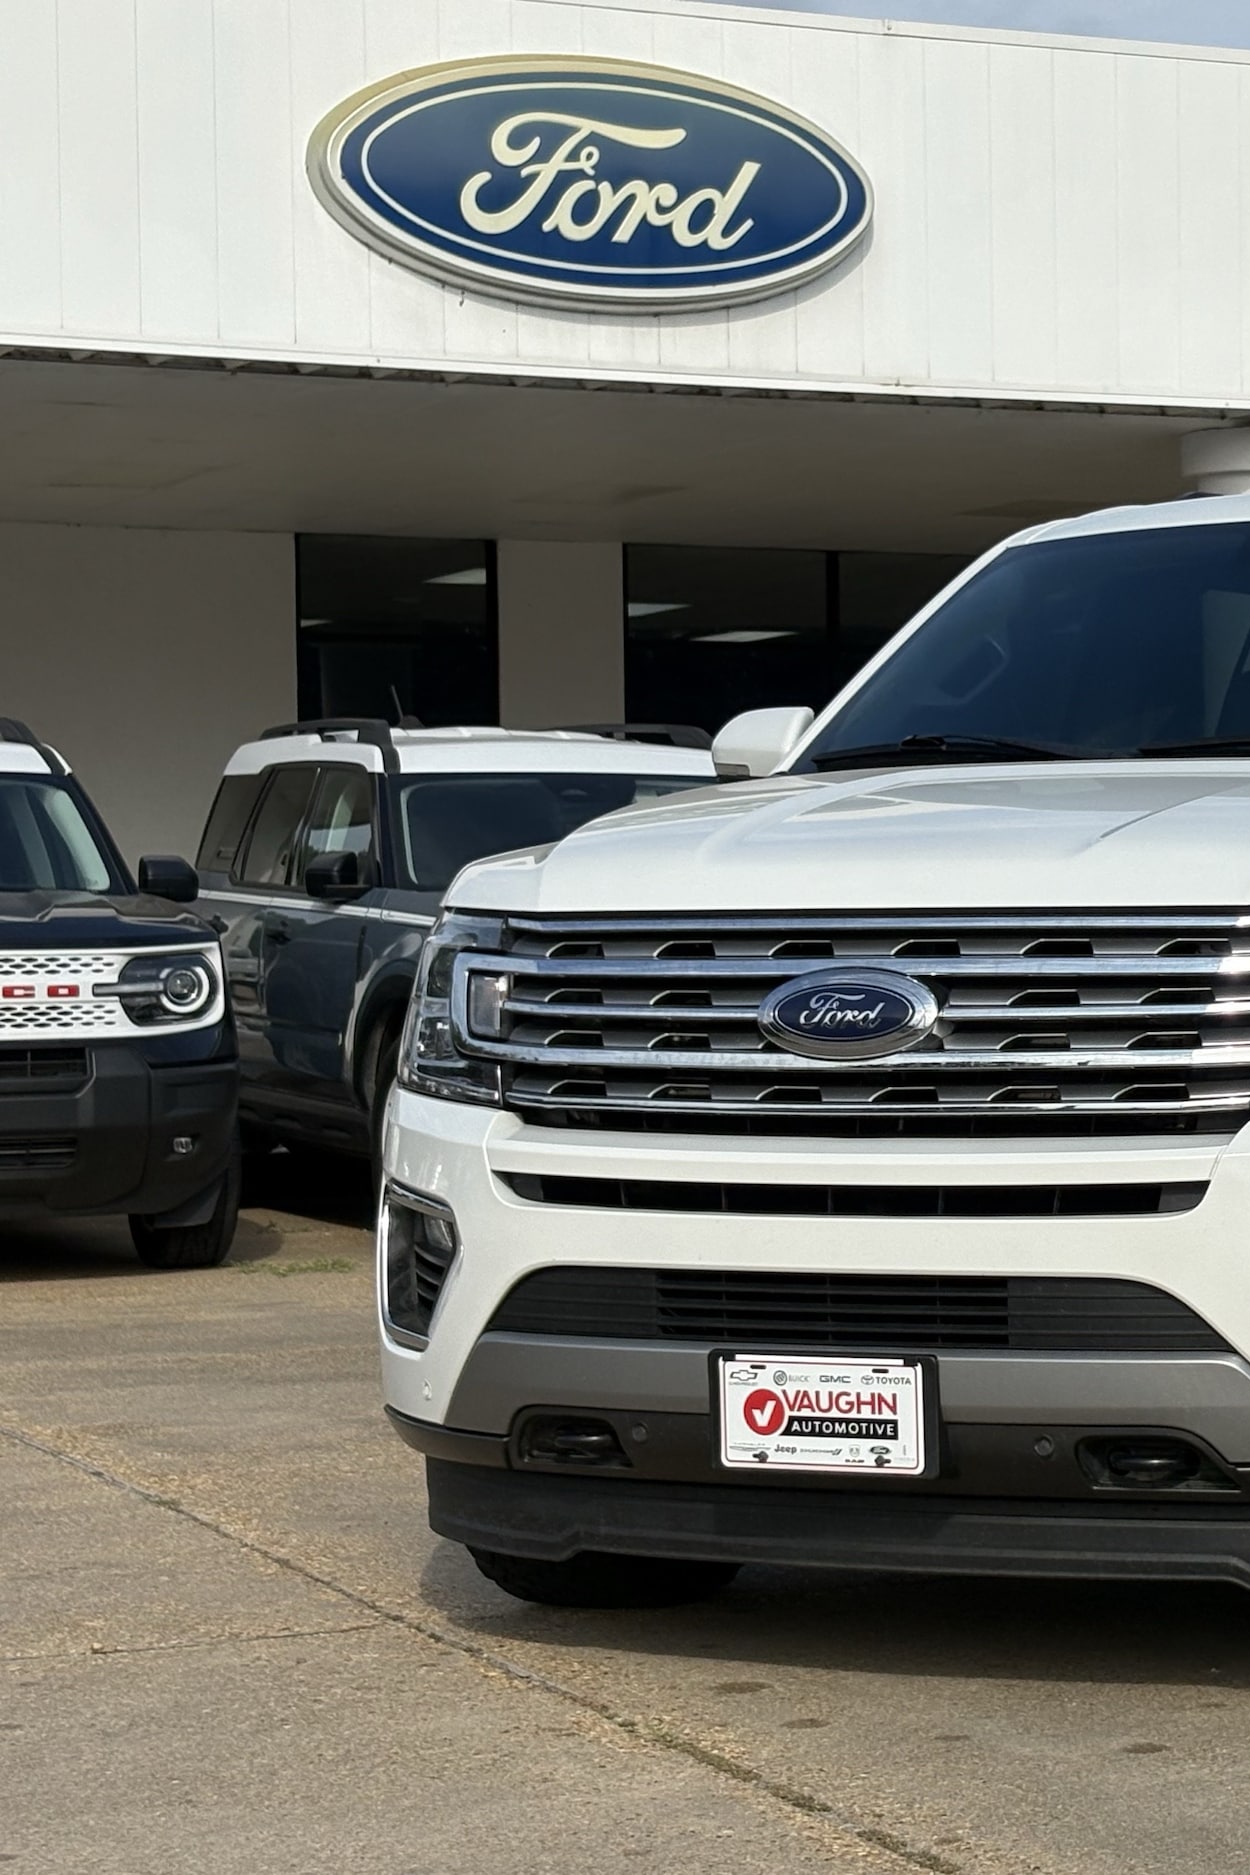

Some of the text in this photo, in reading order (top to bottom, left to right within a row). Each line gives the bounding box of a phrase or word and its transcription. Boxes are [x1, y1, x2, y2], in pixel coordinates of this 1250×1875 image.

[460, 112, 761, 250] Ford
[799, 992, 886, 1029] Ford
[819, 1375, 851, 1384] GMC
[875, 1376, 912, 1386] TOYOTA
[781, 1389, 897, 1415] VAUGHN
[791, 1420, 896, 1436] AUTOMOTIVE
[774, 1443, 798, 1455] Jeep
